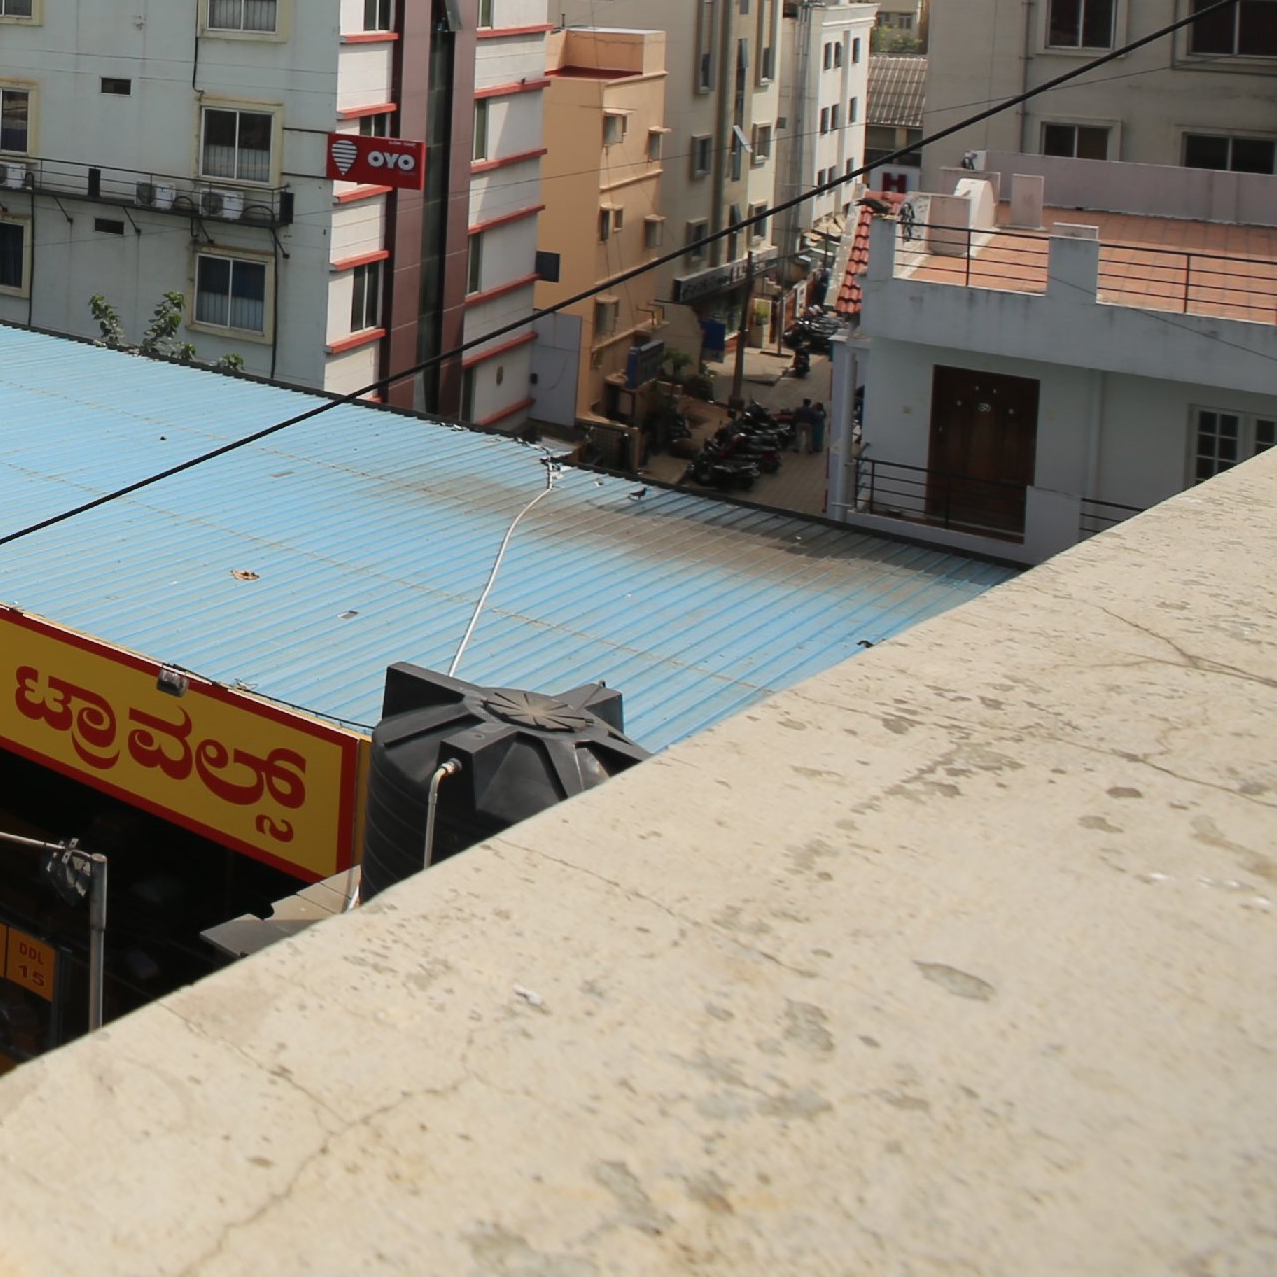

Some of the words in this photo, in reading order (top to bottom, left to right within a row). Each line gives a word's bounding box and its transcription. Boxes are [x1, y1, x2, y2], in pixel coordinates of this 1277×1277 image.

[367, 150, 415, 171] OYO
[18, 941, 45, 966] DDL
[17, 964, 45, 987] 15
